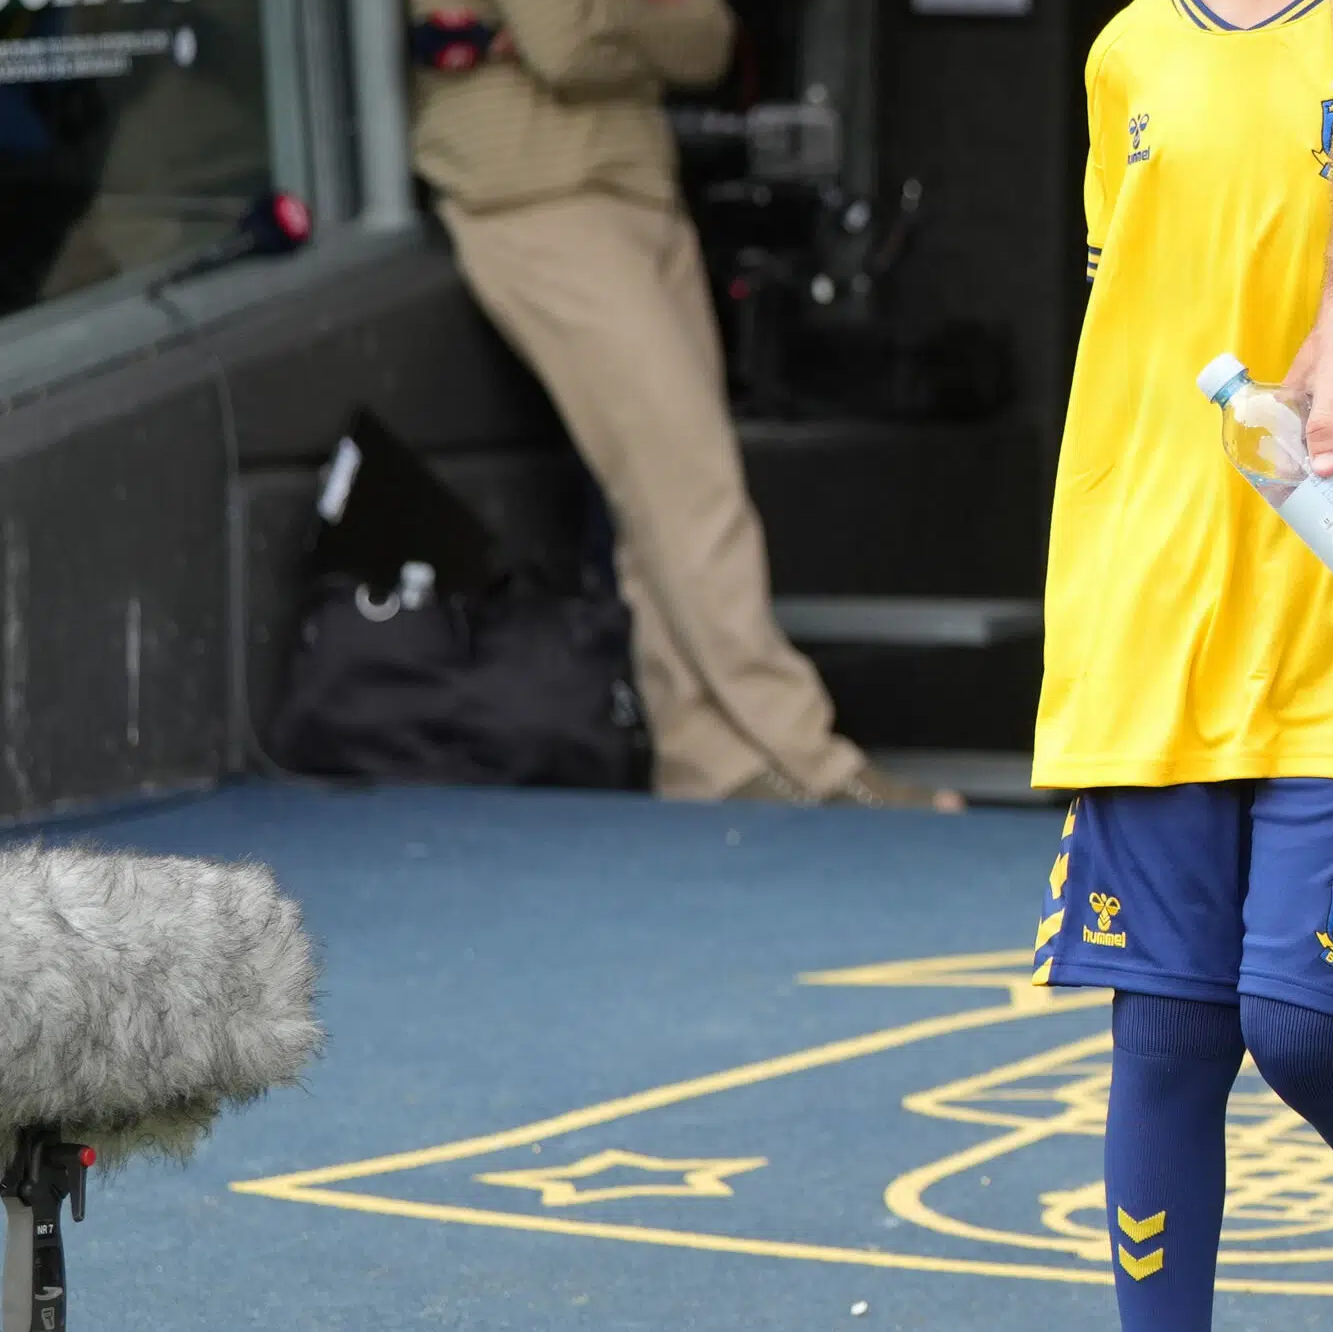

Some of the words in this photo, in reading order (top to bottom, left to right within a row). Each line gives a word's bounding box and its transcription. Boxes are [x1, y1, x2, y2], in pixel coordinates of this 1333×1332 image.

[1083, 924, 1126, 949] hummel
[37, 1224, 48, 1235] NR
[48, 1224, 54, 1235] 7
